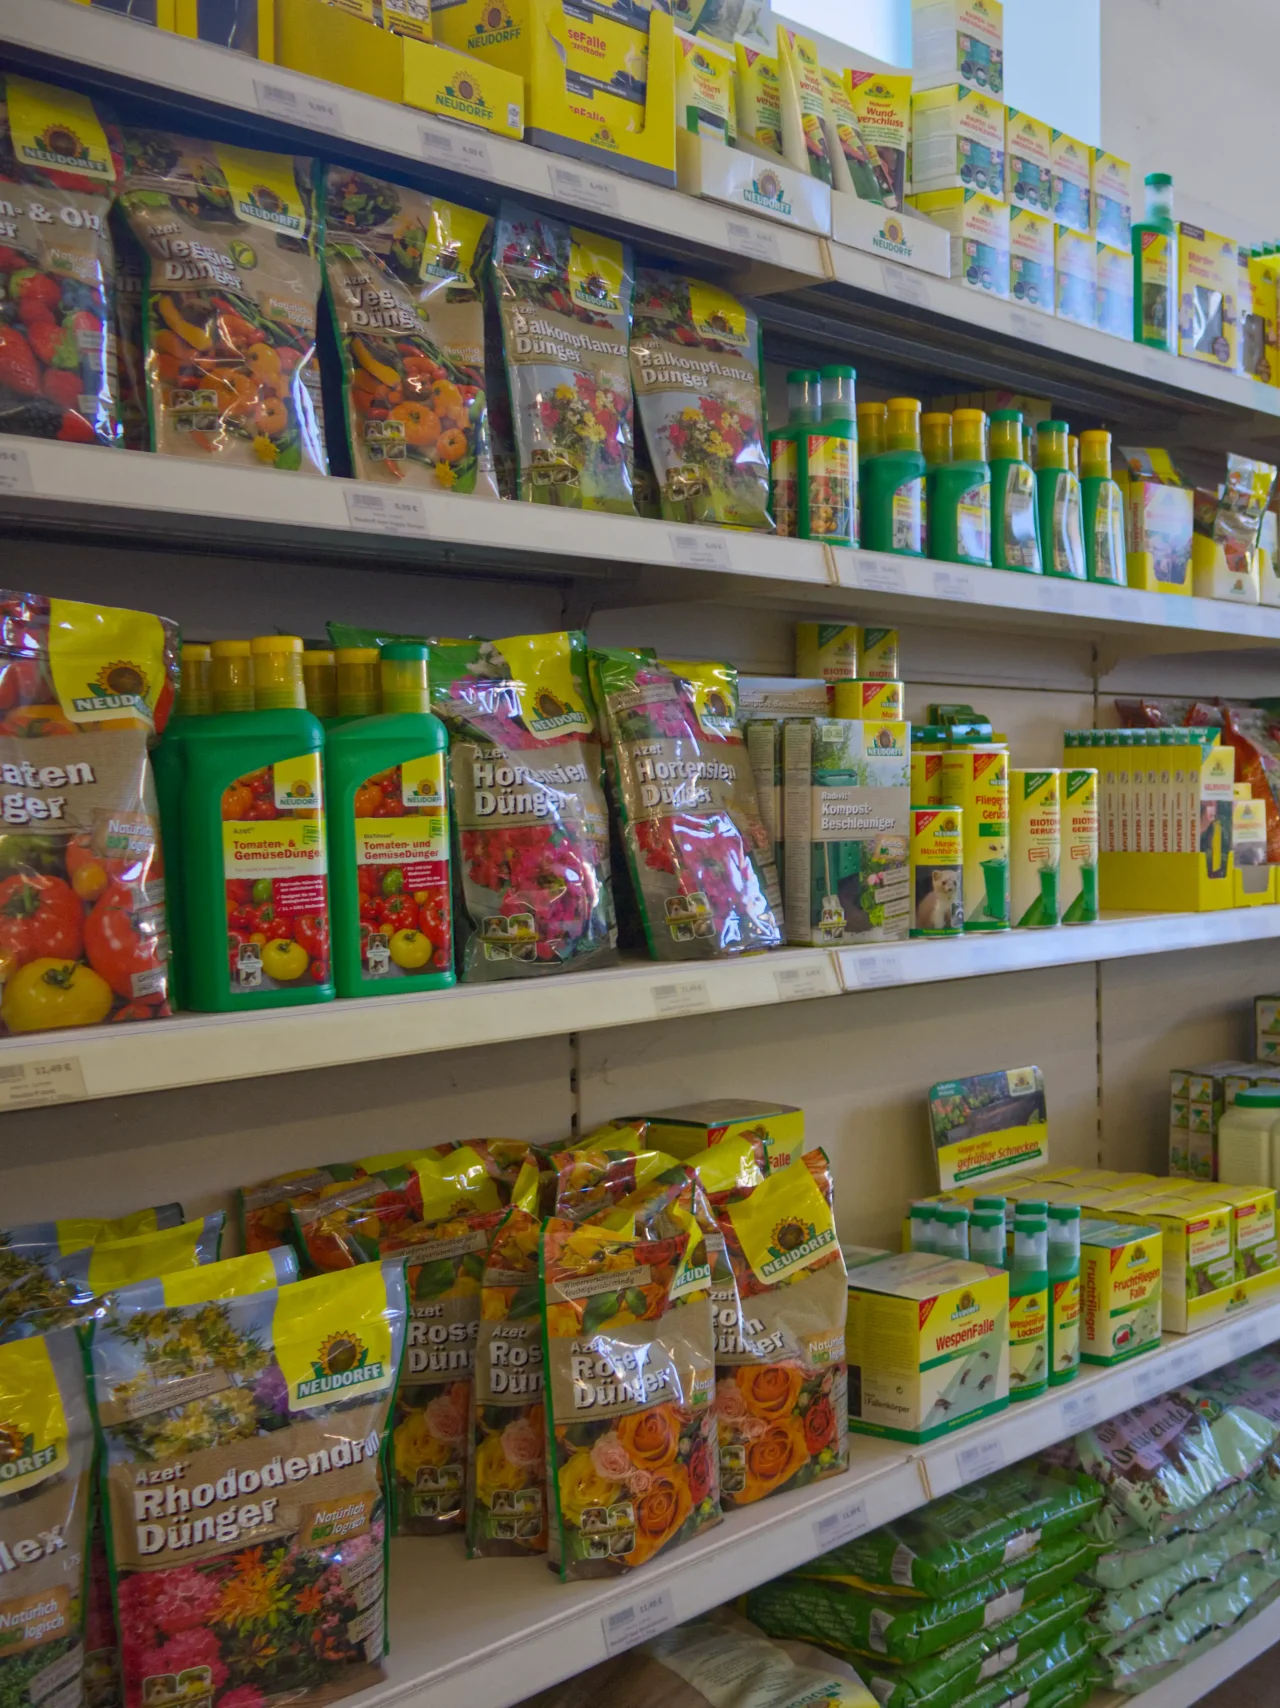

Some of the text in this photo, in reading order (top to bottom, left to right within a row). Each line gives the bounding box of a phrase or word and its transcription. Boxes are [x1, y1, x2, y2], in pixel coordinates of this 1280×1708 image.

[467, 28, 521, 49] NEUDORFF
[435, 94, 493, 120] NEUDORFF
[866, 107, 897, 118] Wund-
[857, 116, 904, 128] verschluss
[24, 148, 106, 171] NEUDORFF
[29, 202, 53, 223] &
[744, 190, 792, 215] NEUDORFF
[240, 203, 300, 229] NEUDORFF
[873, 237, 912, 257] NEUDORFF
[517, 335, 581, 363] Dünger
[642, 369, 709, 388] Dünger
[2, 761, 96, 789] aten
[3, 792, 67, 824] ger
[821, 803, 872, 816] Kompost-
[821, 818, 896, 832] Beschleuniger
[234, 839, 296, 850] Tomaten- &
[234, 848, 321, 861] GemüseDünge
[364, 840, 431, 850] Tomaten- und
[364, 850, 439, 860] GemüseDünger
[763, 1230, 834, 1277] NEUDORFF
[711, 1288, 736, 1301] zet
[1129, 1285, 1147, 1300] Falle
[492, 1326, 526, 1338] Azet
[936, 1318, 995, 1352] WespenFalle
[409, 1347, 473, 1373] Dün
[299, 1363, 384, 1397] NEUDORFF
[135, 1463, 187, 1486] Azet
[315, 1501, 365, 1525] Natürlich
[135, 1497, 279, 1555] Dünger
[312, 1515, 366, 1541] BIOlogisch
[2, 1525, 67, 1572] lex
[0, 1598, 58, 1628] Natürlich
